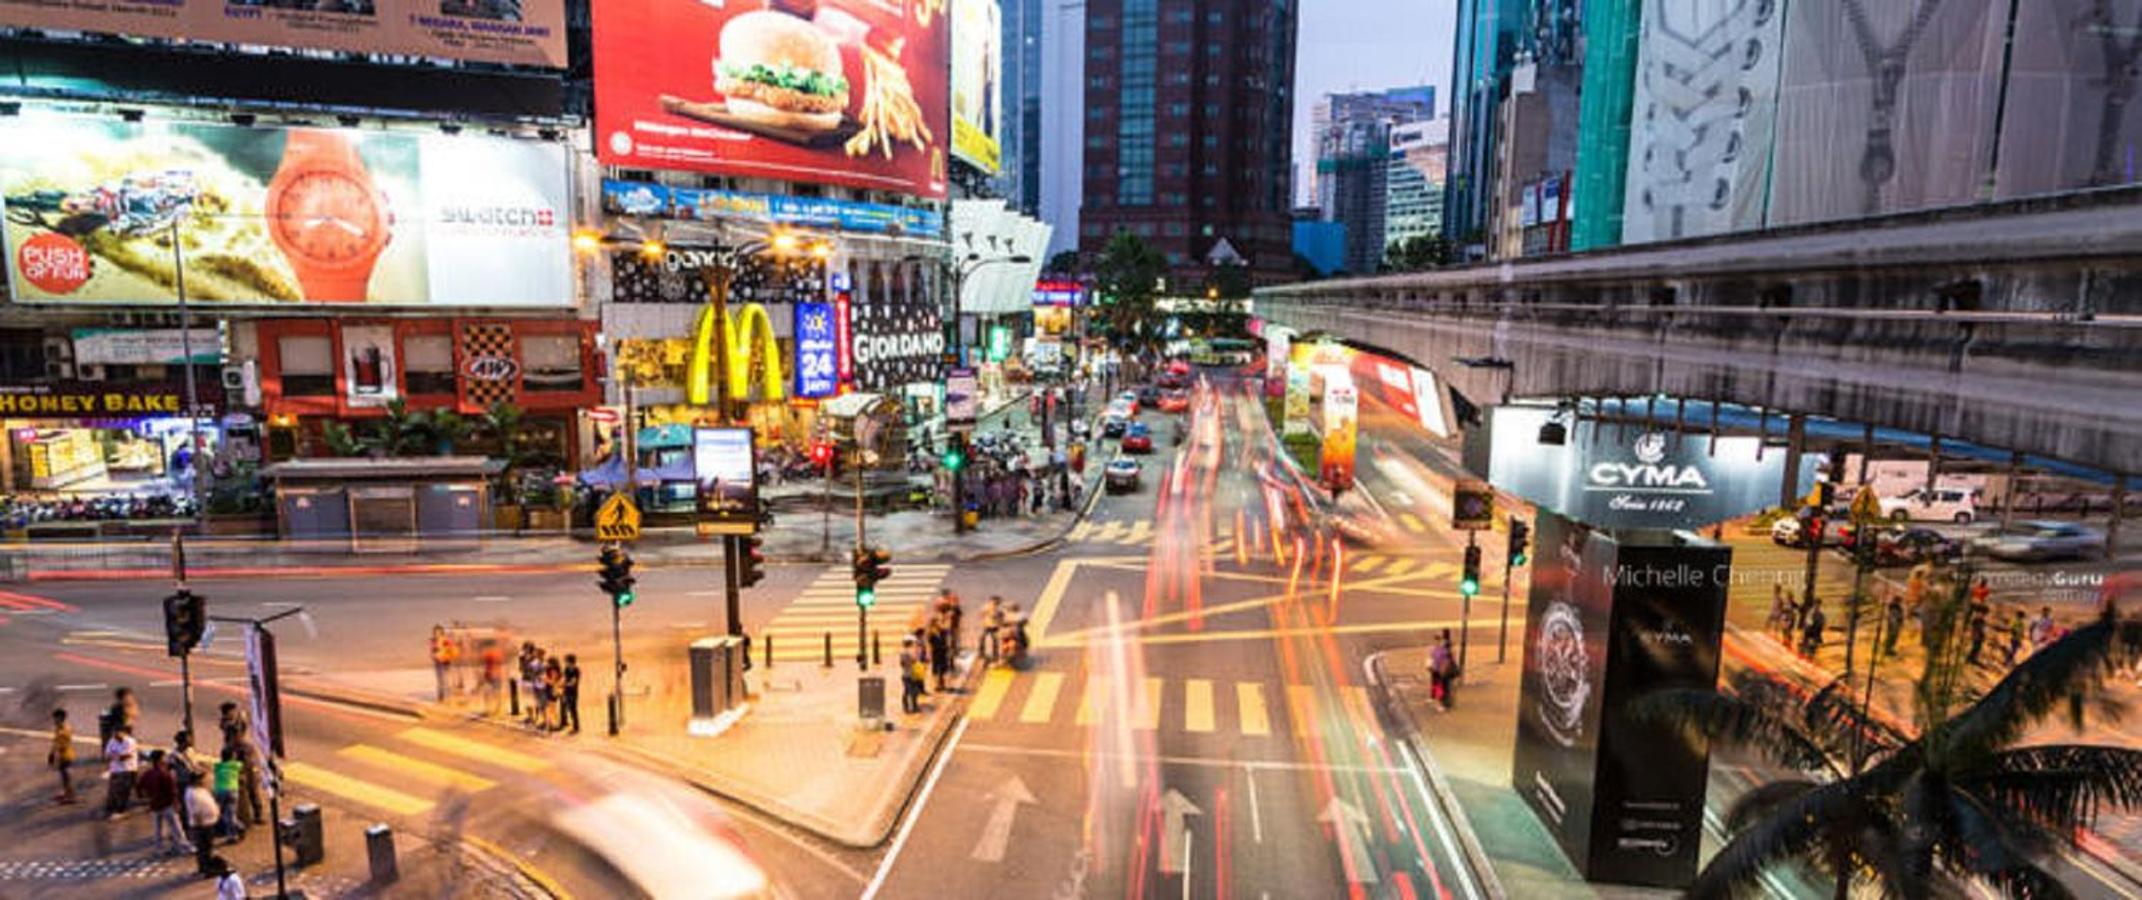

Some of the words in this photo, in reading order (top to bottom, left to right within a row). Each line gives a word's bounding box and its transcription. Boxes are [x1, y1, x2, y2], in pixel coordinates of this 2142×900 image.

[22, 246, 84, 267] PUSH
[853, 332, 945, 365] GIORDANO
[801, 353, 834, 377] 24
[0, 394, 96, 412] HONEY
[103, 393, 180, 412] BAKE
[1590, 462, 1707, 487] CYMA
